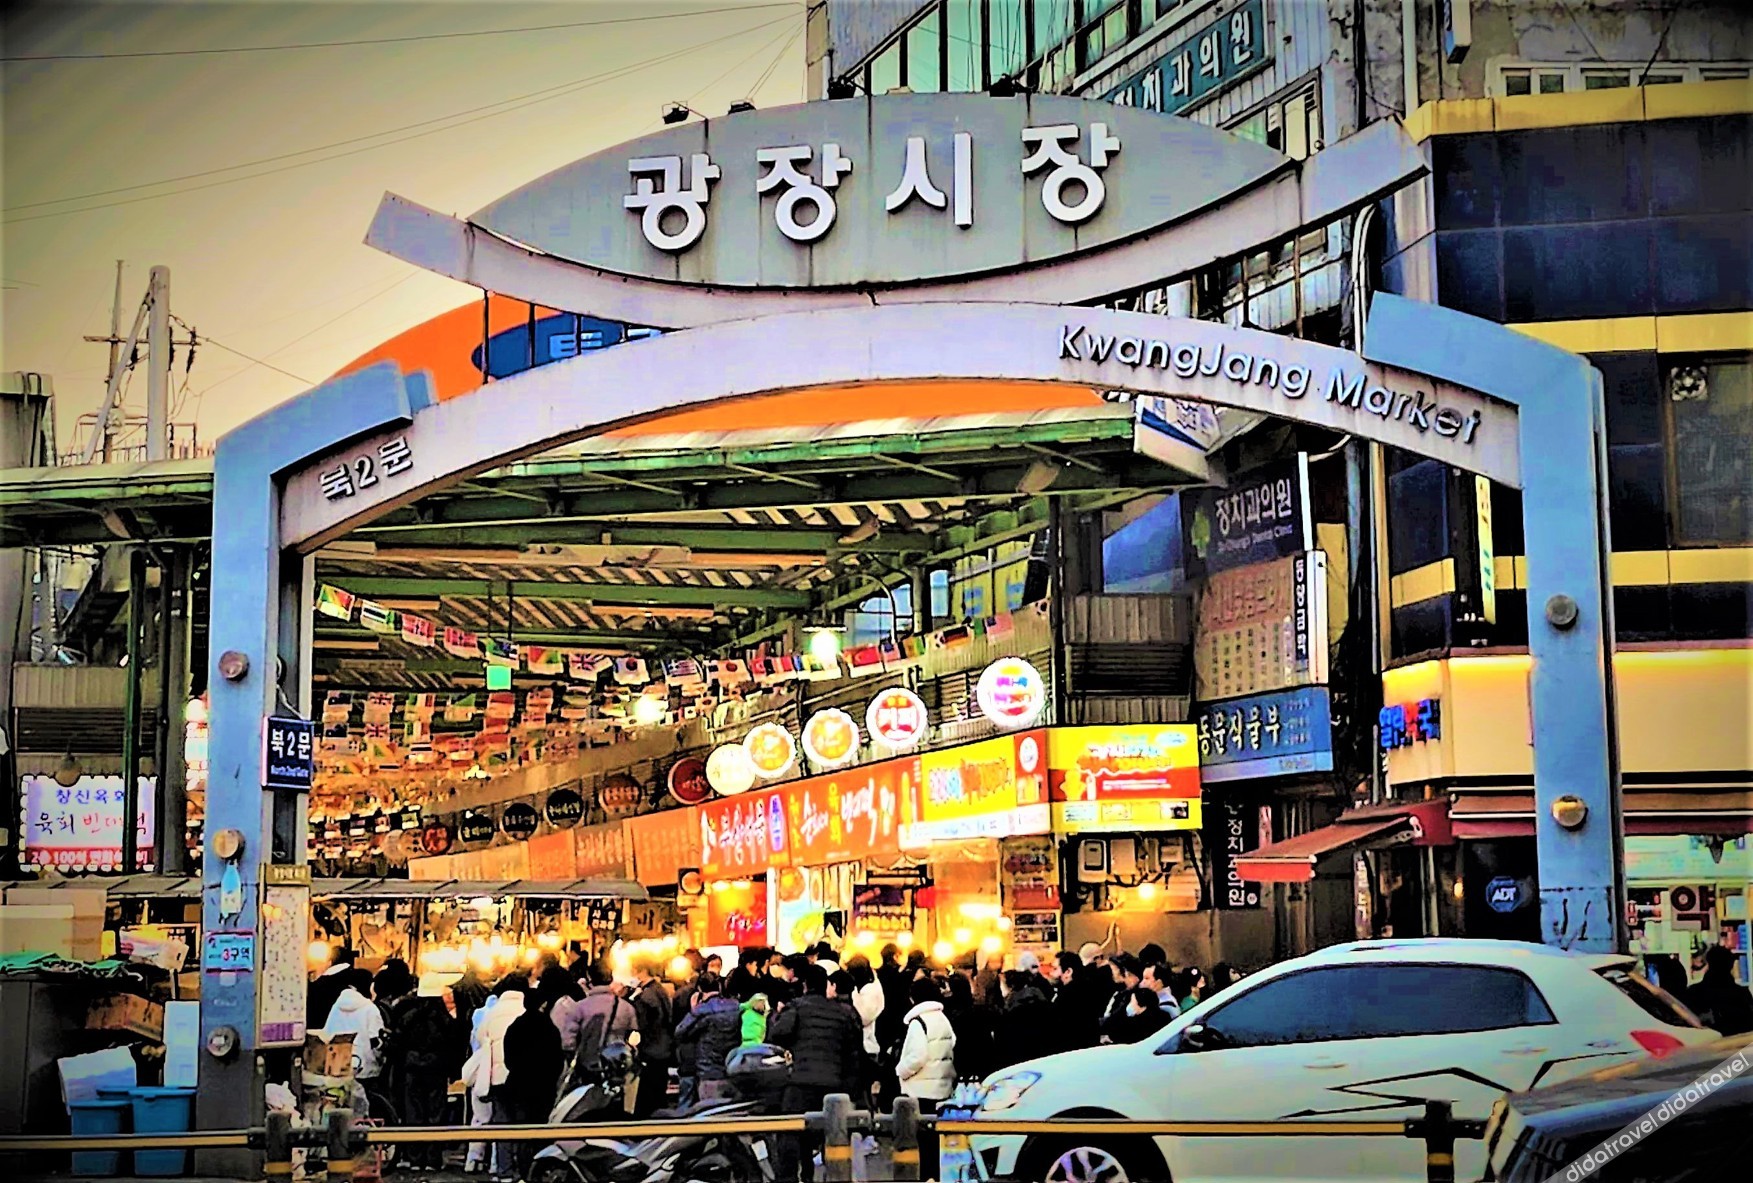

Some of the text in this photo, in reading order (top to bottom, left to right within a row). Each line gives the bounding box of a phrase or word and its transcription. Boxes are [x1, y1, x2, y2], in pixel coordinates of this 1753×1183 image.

[624, 122, 1121, 253] 광장시장
[1057, 323, 1482, 445] KwangJang Market
[318, 435, 413, 500] 북2문
[270, 728, 311, 760] 북2문
[34, 811, 75, 835] 육회
[1492, 887, 1516, 903] ADT
[1671, 885, 1716, 931] 약
